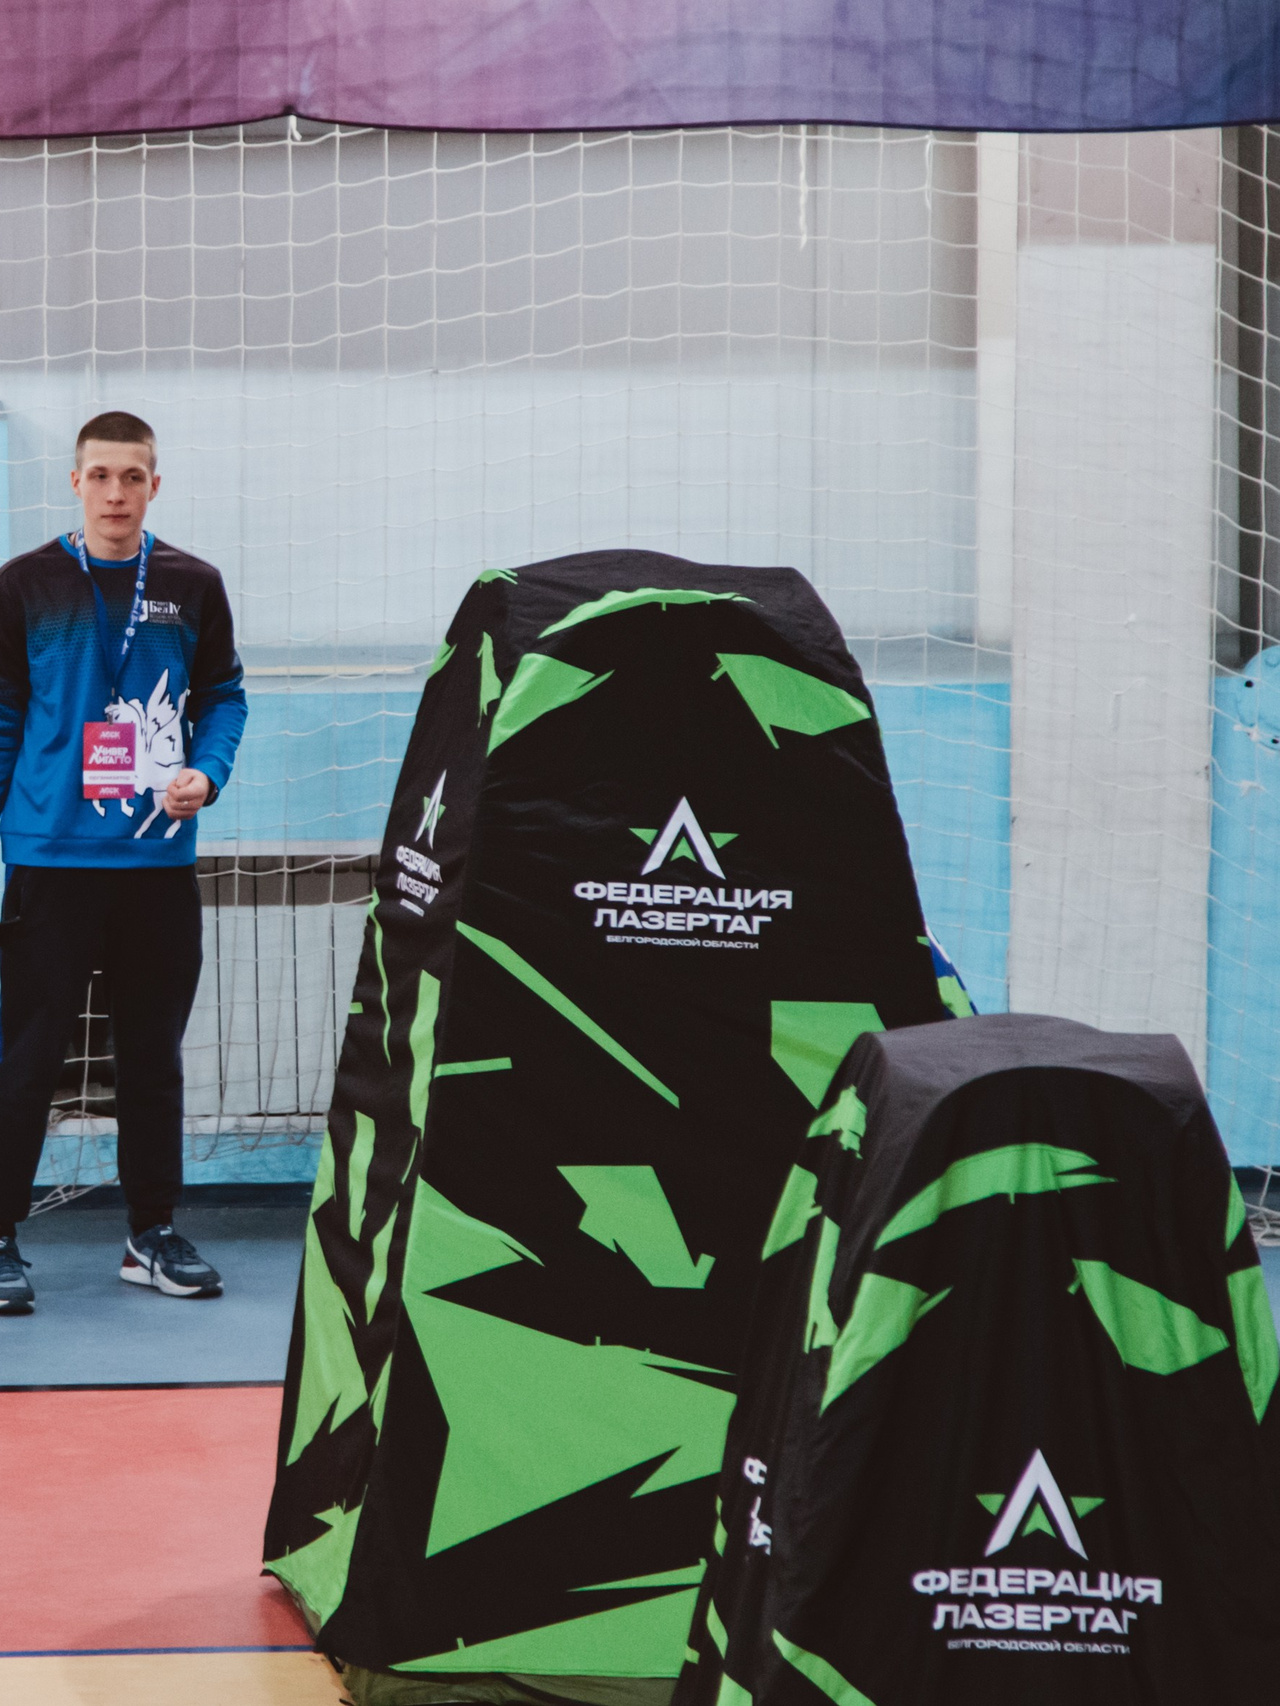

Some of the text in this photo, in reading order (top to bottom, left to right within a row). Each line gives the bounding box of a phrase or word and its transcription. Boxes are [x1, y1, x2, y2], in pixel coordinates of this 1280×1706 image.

[574, 881, 793, 910] ФЕДЕРАЦИЯ
[594, 908, 772, 935] ЛАЗЕРТАГ
[606, 935, 759, 949] БЕЛГОРОДСКОЙ ОБЛАСТИ
[912, 1567, 1163, 1604] ФЕДЕРАЦИЯ
[933, 1603, 1138, 1634] ЛАЗЕРТАГ
[1063, 1642, 1131, 1654] ОБЛАСТИ
